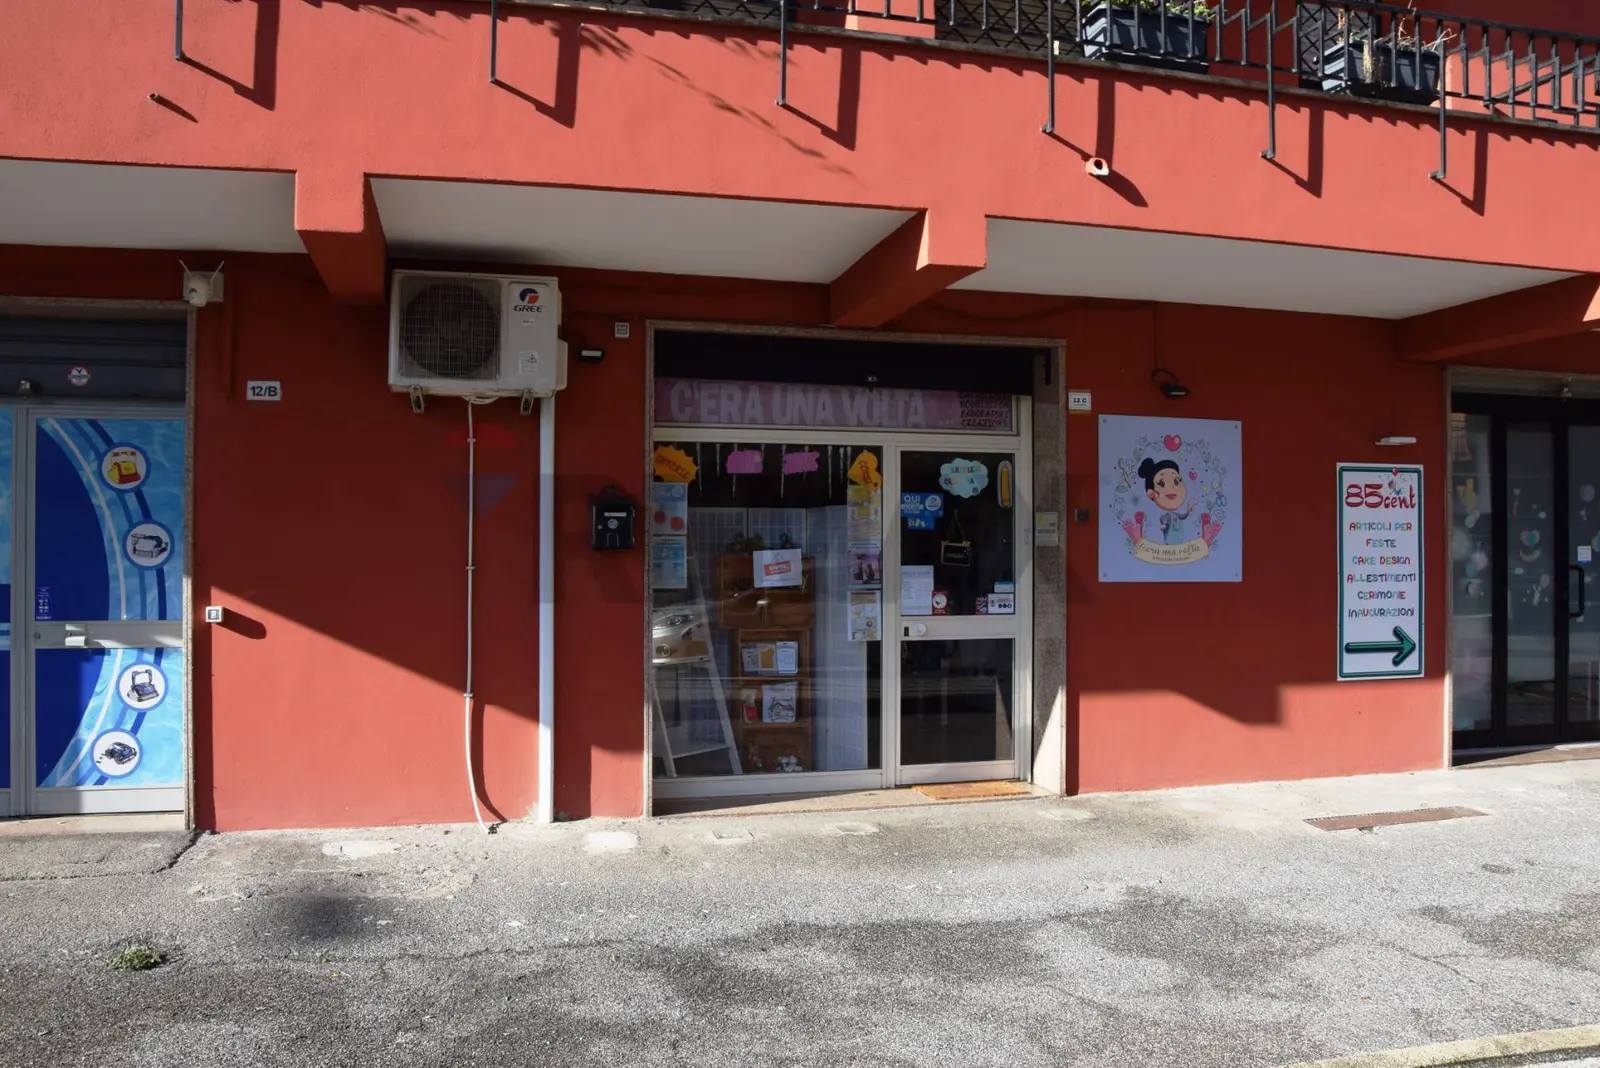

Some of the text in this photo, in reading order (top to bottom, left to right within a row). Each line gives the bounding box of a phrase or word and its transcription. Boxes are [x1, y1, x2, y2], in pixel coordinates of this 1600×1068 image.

[513, 304, 545, 313] GREE
[249, 385, 278, 398] 12/B
[669, 380, 764, 424] C'ERA
[772, 385, 834, 425] UNA
[841, 387, 927, 428] VOLTA
[904, 495, 921, 504] QUI
[1349, 522, 1413, 531] ARTICOLI PER
[1366, 539, 1397, 548] FESTE
[1352, 556, 1376, 565] CAKE
[1346, 573, 1416, 583] ALLESTIMENTI
[1357, 590, 1406, 600] CERIMONIE
[1348, 608, 1415, 617] INAUGURAZIONI
